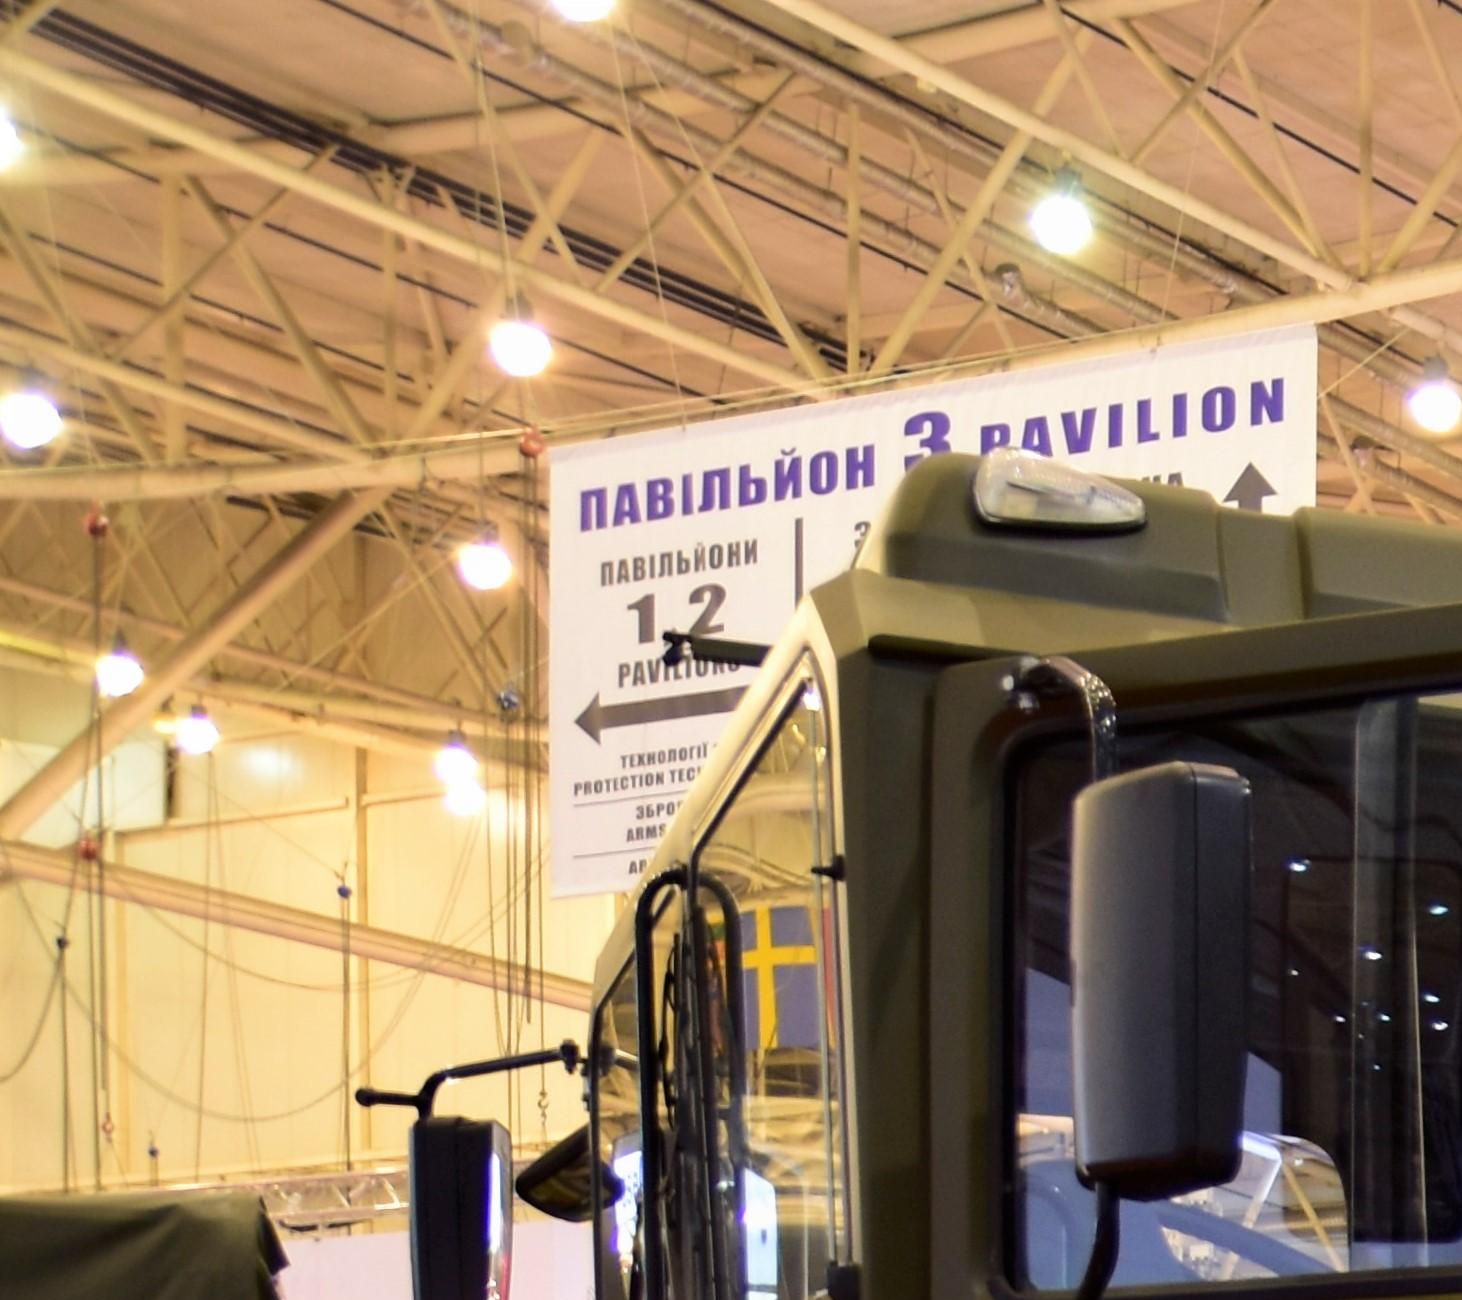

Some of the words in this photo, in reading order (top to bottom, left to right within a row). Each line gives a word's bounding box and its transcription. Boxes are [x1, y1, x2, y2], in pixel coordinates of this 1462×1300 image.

[580, 444, 875, 532] ПАВІЛЬЙОН
[980, 377, 1285, 457] PAVILION
[600, 539, 758, 586] ПАВІЛЬЙОНИ
[620, 741, 708, 768] ТЕХНОЛОГІЇ
[573, 770, 664, 796] PROTECTION
[670, 767, 701, 786] TEC
